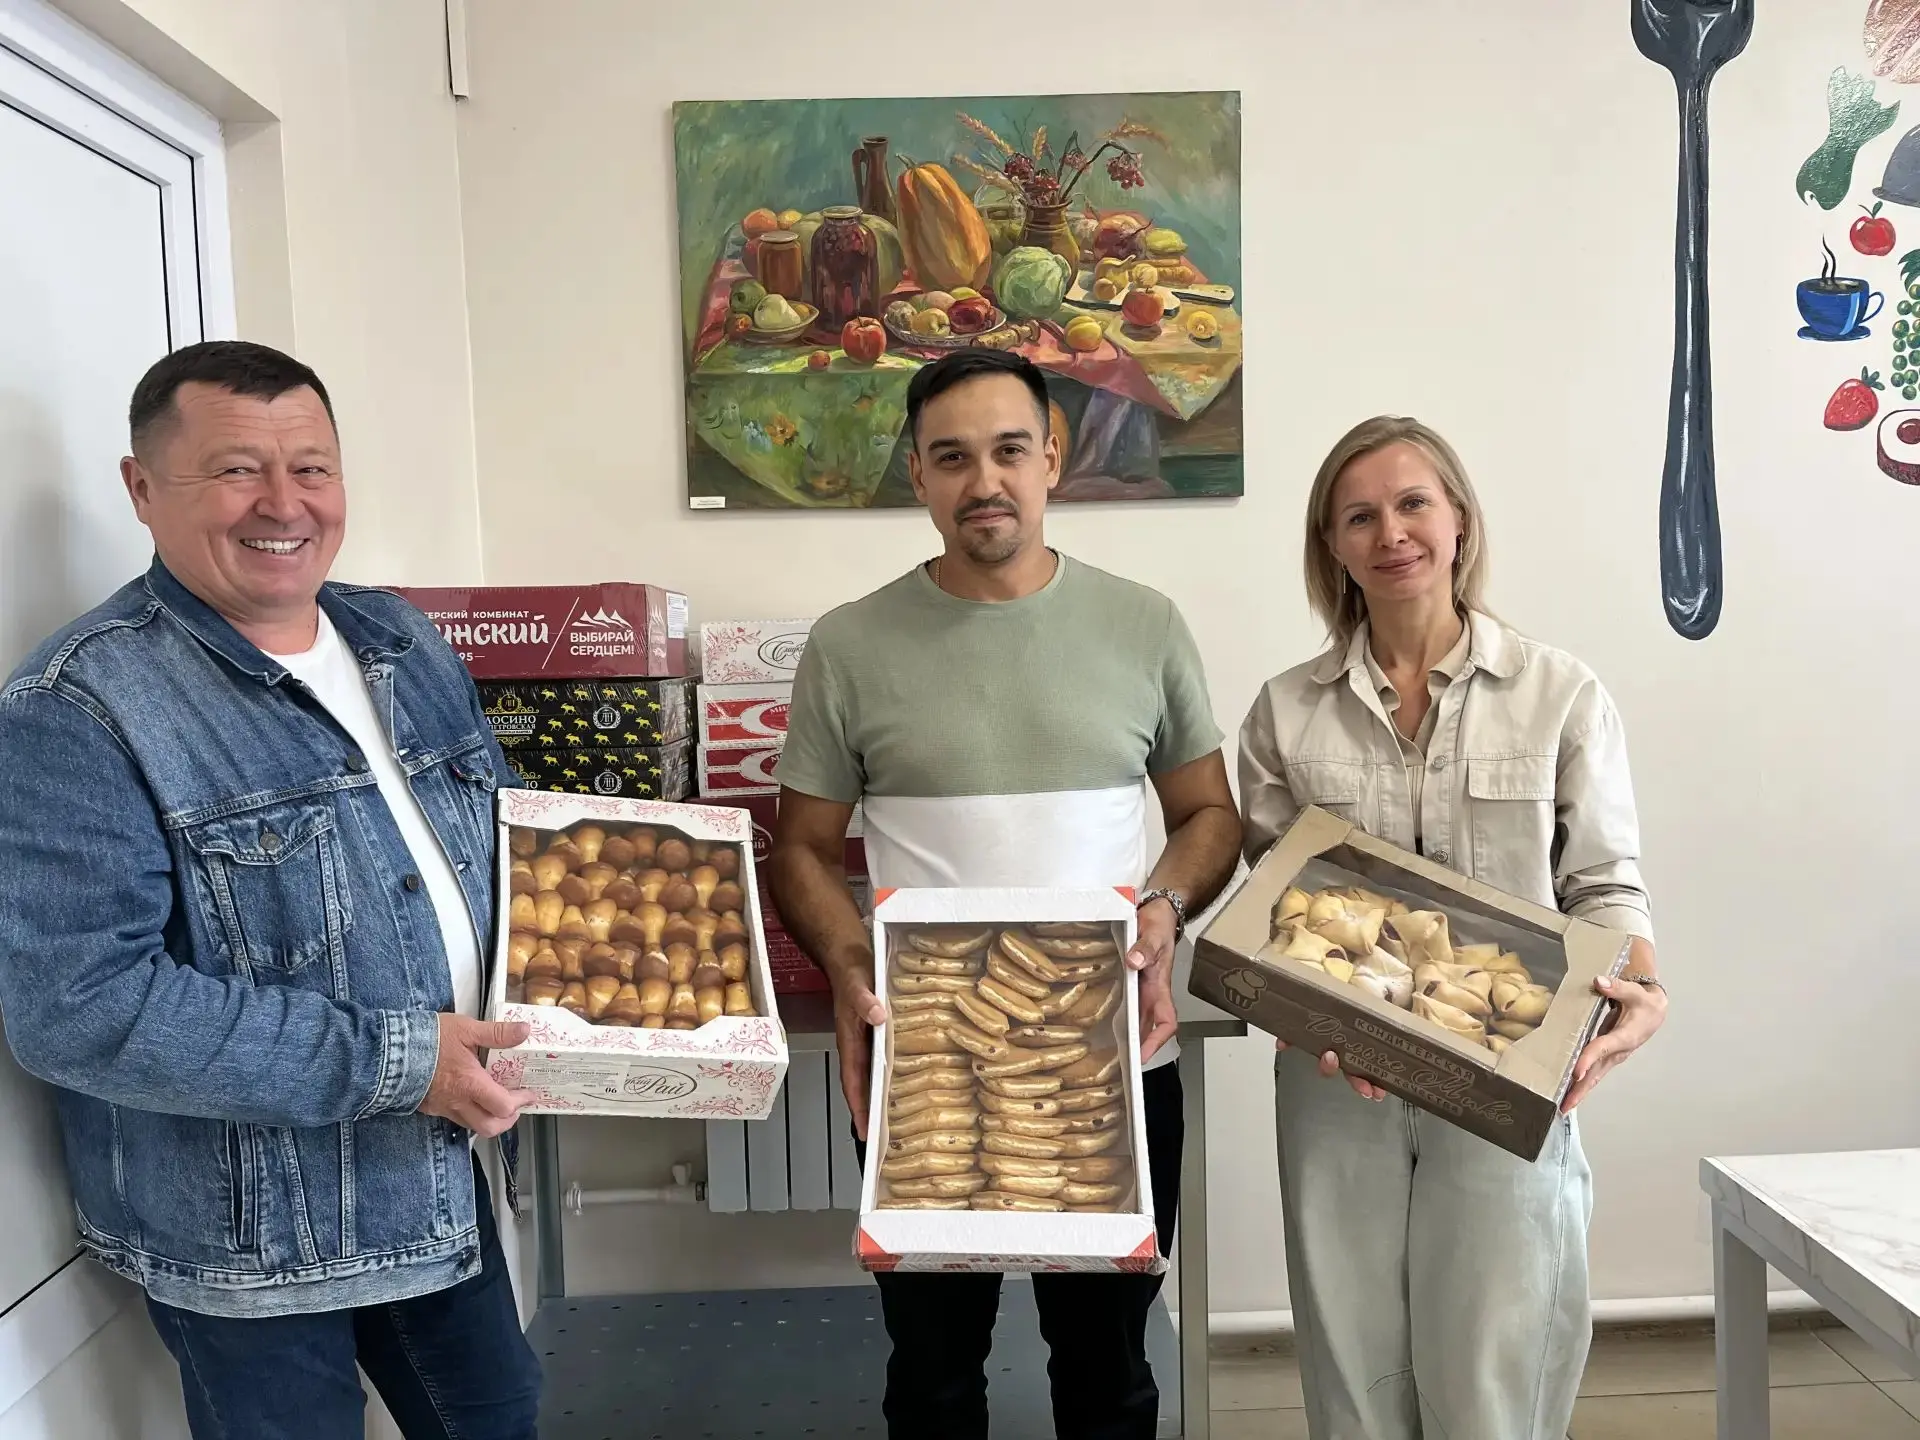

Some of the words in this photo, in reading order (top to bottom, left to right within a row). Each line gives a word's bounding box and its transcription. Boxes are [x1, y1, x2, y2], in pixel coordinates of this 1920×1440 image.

[424, 610, 468, 620] ЕРСКИЙ
[473, 610, 530, 619] КОМБИНАТ
[570, 629, 635, 643] ВЫБИРАЙ
[570, 645, 635, 658] СЕРДЦЕМ!
[1356, 1019, 1473, 1080] КОНДИТЕРСКАЯ
